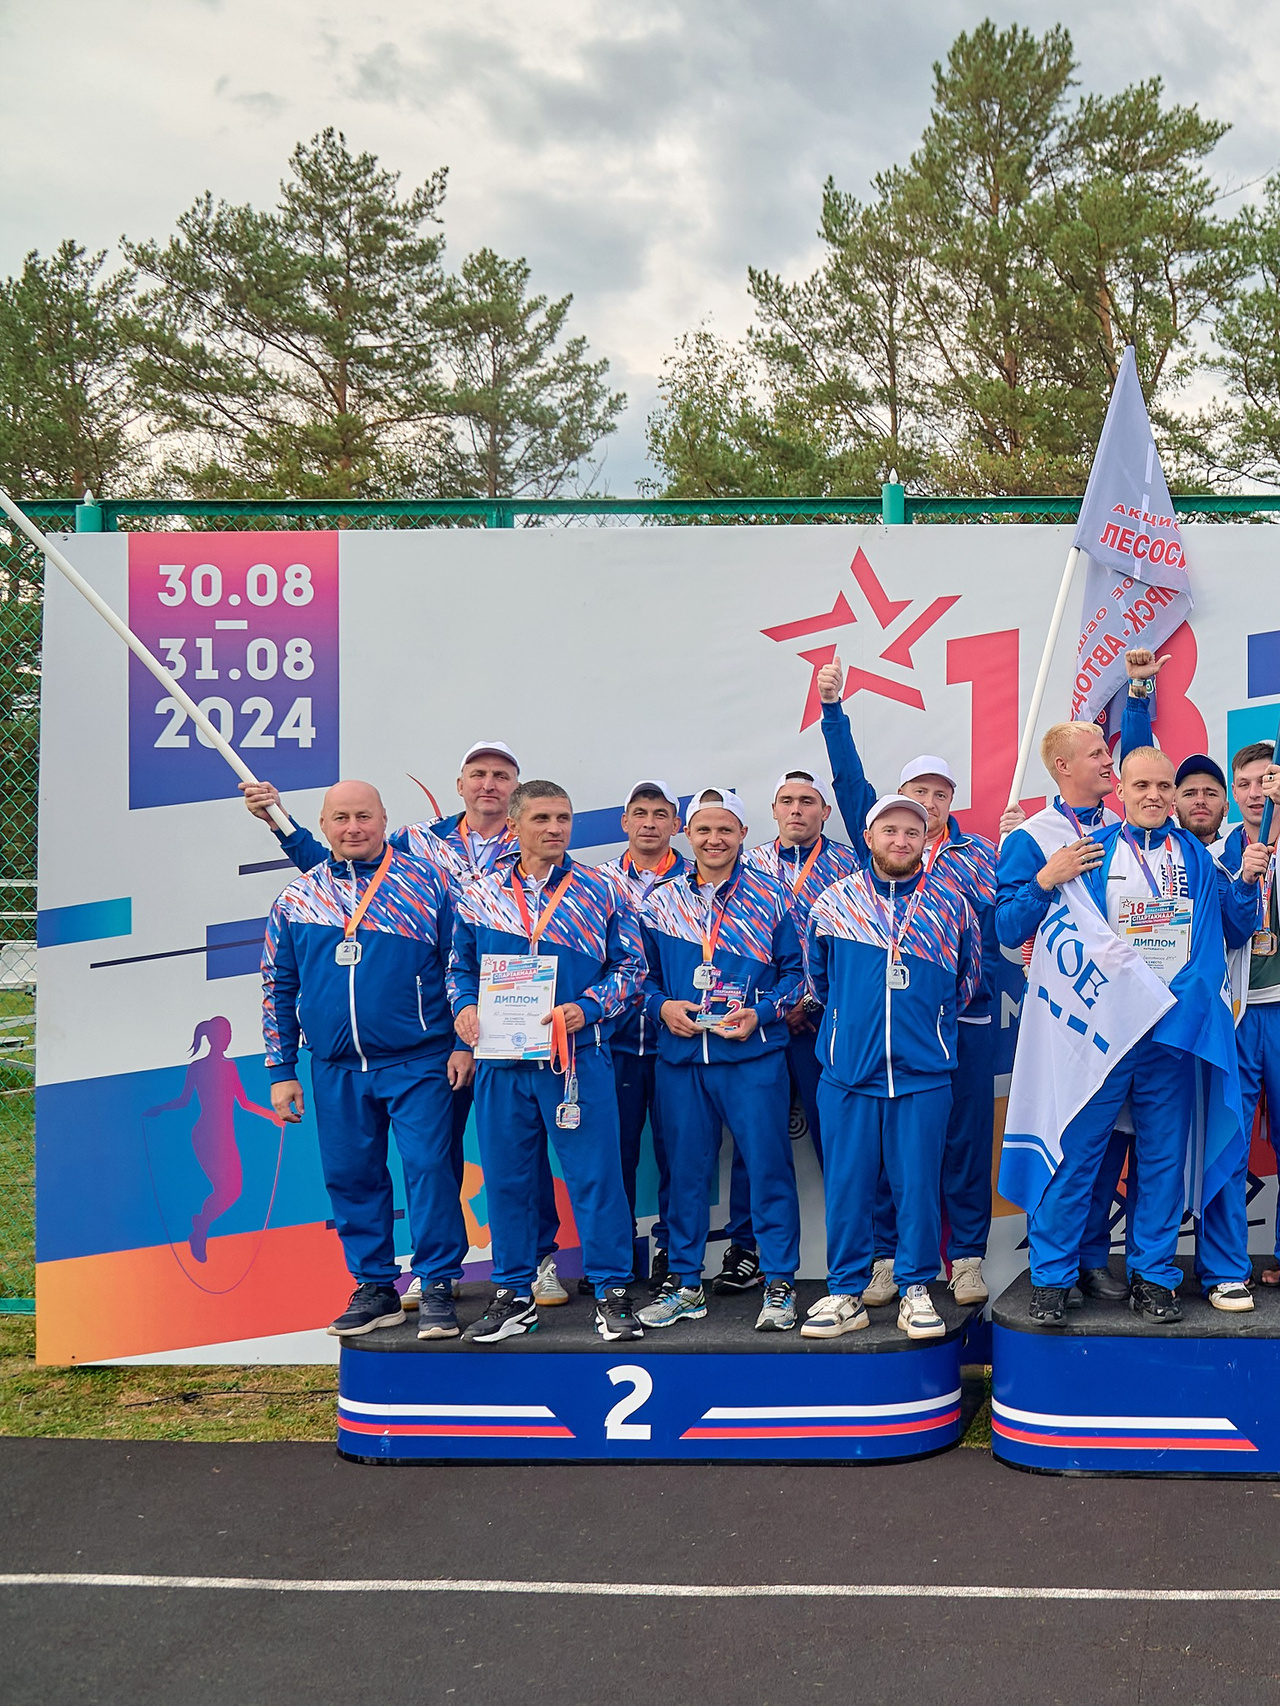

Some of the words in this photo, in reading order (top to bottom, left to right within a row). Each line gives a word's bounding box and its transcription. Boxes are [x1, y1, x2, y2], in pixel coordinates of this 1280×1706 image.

[157, 563, 315, 607] 30.08
[157, 637, 315, 681] 31.08
[154, 695, 316, 749] 2024
[1130, 902, 1145, 915] 18
[1131, 912, 1175, 923] СПАРТАКИАДА
[343, 945, 350, 953] 2
[1132, 938, 1176, 948] ДИПЛОМ
[491, 960, 507, 973] 18
[493, 969, 538, 980] СПАРТАКИАДА
[494, 995, 539, 1004] ДИПЛОМ
[605, 1364, 654, 1441] 2
